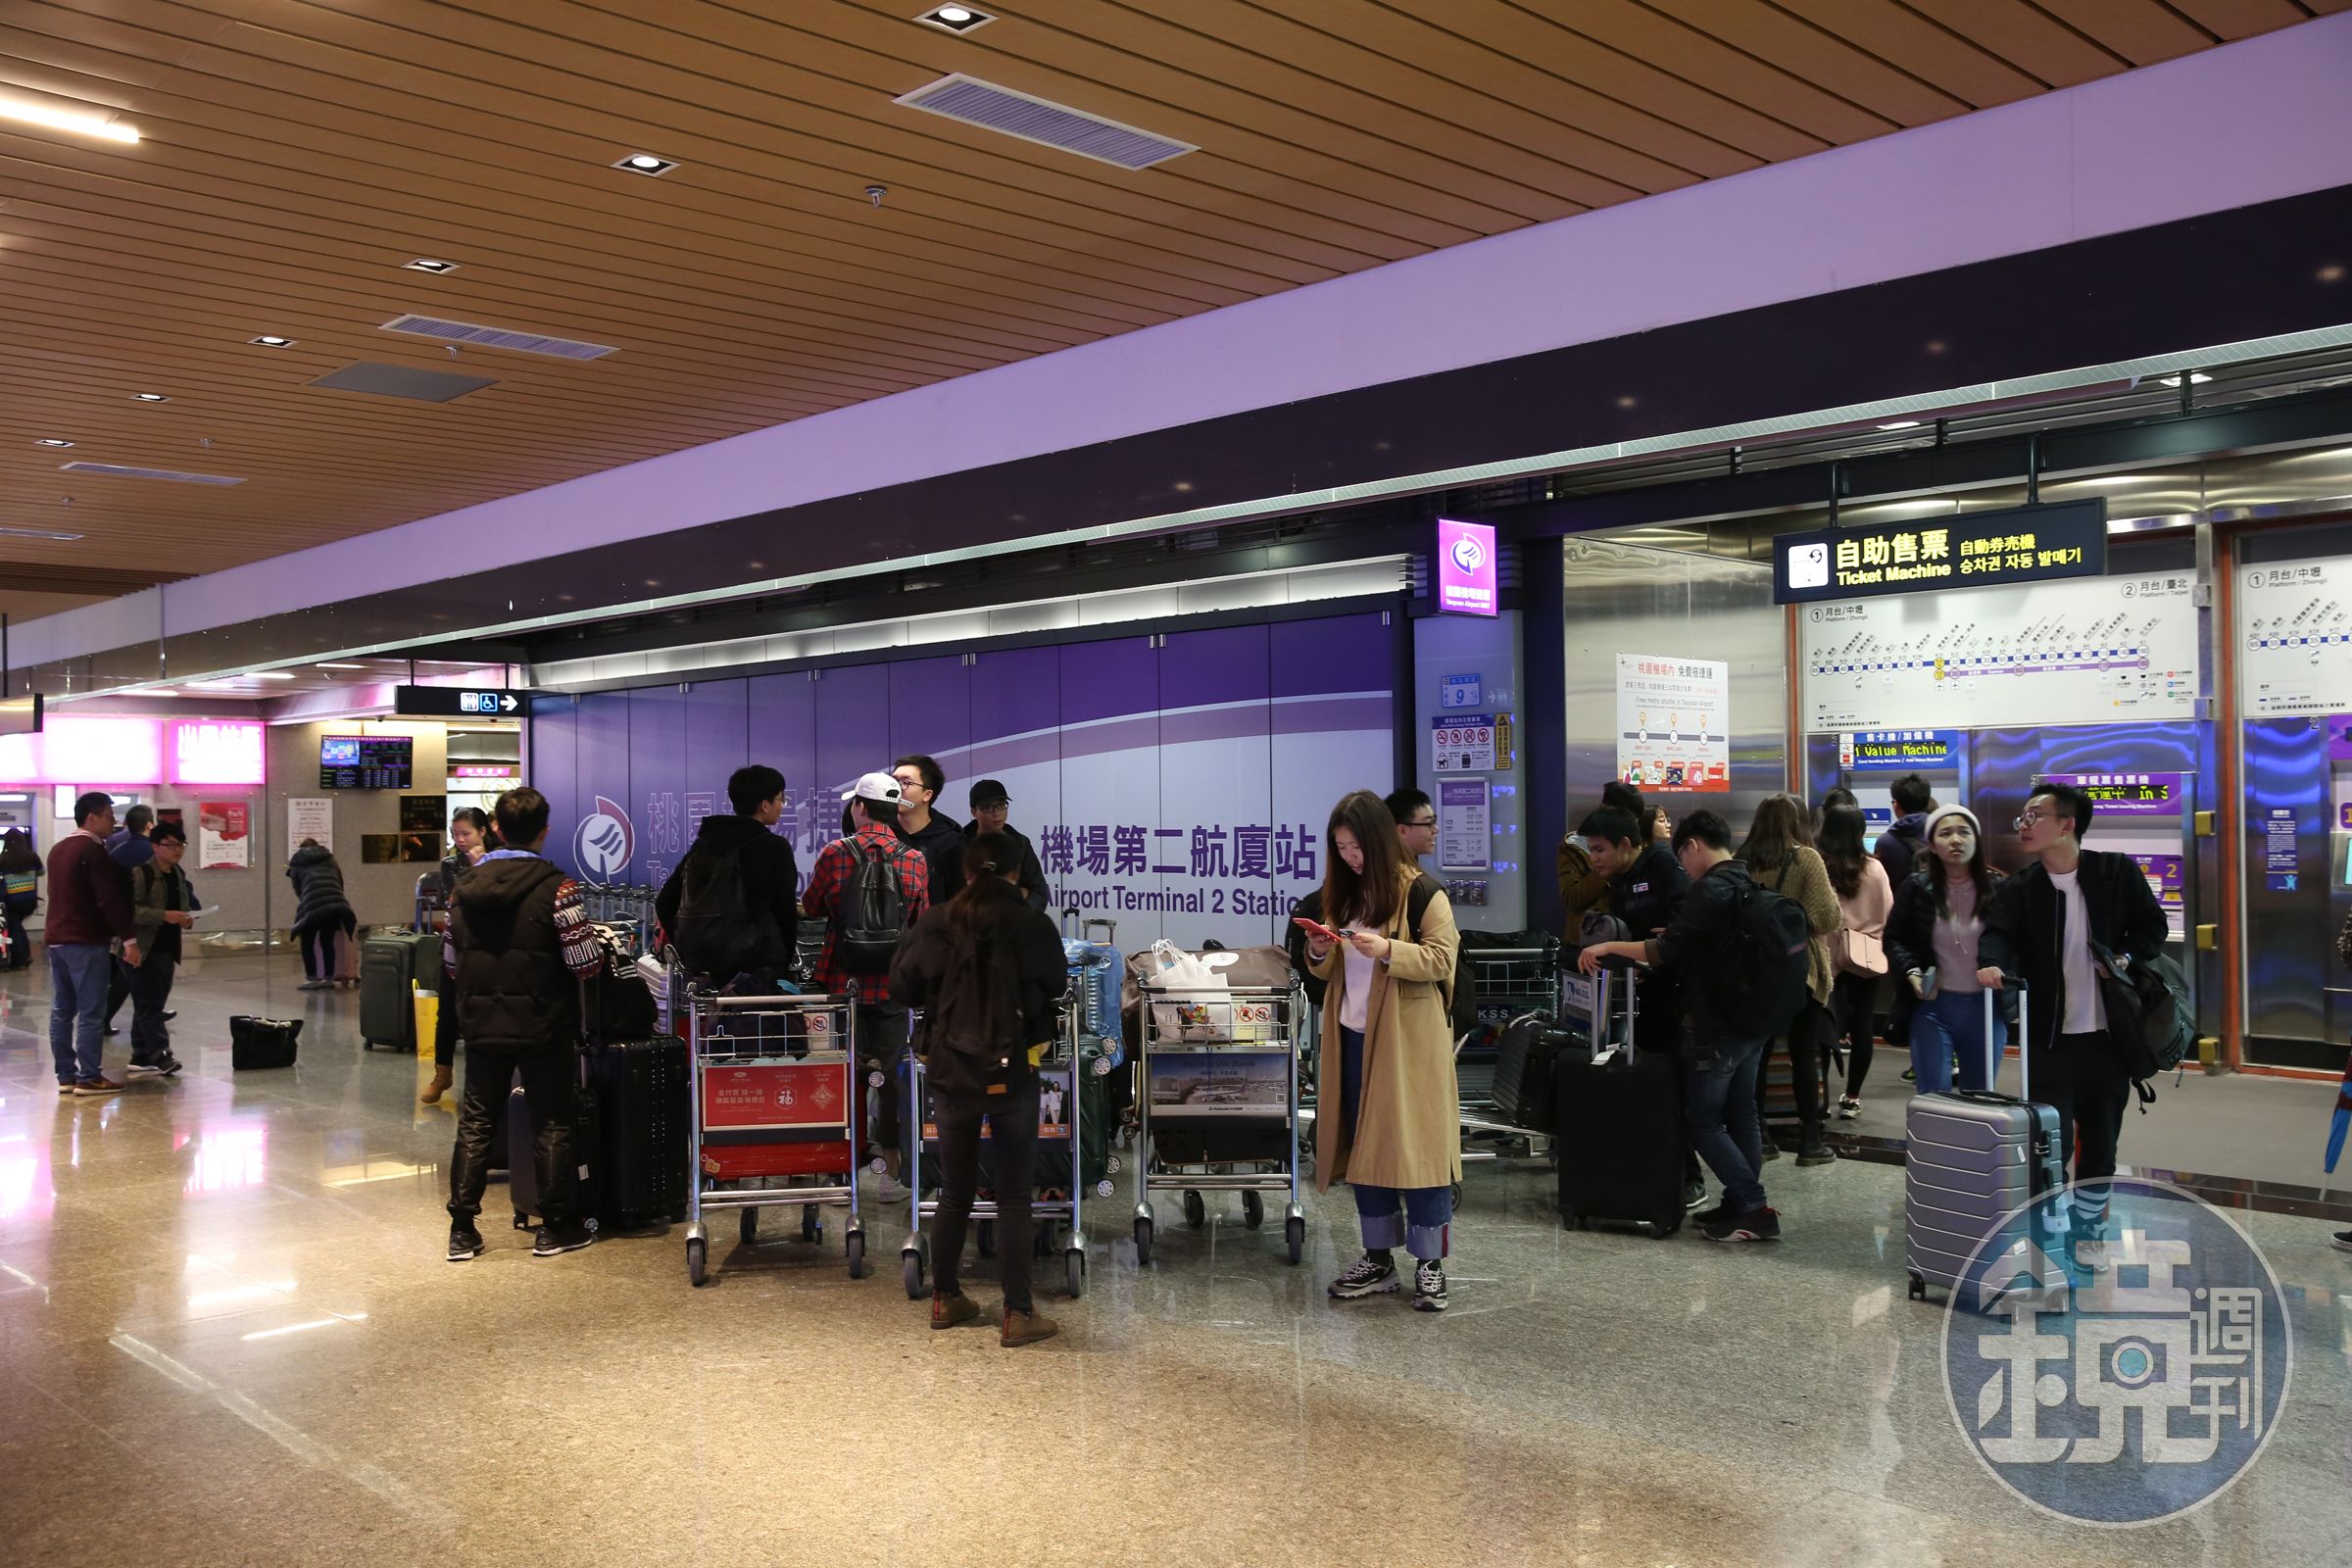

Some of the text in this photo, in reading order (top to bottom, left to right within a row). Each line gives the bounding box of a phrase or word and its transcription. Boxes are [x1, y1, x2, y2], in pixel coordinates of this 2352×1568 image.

[1837, 529, 1949, 569] 自助售票
[1960, 533, 2035, 556] 自動券売機
[1960, 547, 2081, 574] 승차권 자동 발매기
[1836, 564, 1952, 586] Ticket Machine
[1456, 689, 1464, 704] 9
[2309, 716, 2320, 730] 2
[1865, 744, 1897, 757] Value
[1040, 824, 1317, 880] 機場第二航廈站
[2166, 863, 2178, 878] 2
[1112, 886, 1204, 912] Terminal
[1211, 889, 1225, 914] 2
[1232, 888, 1303, 917] Statio
[778, 1090, 794, 1105] 福
